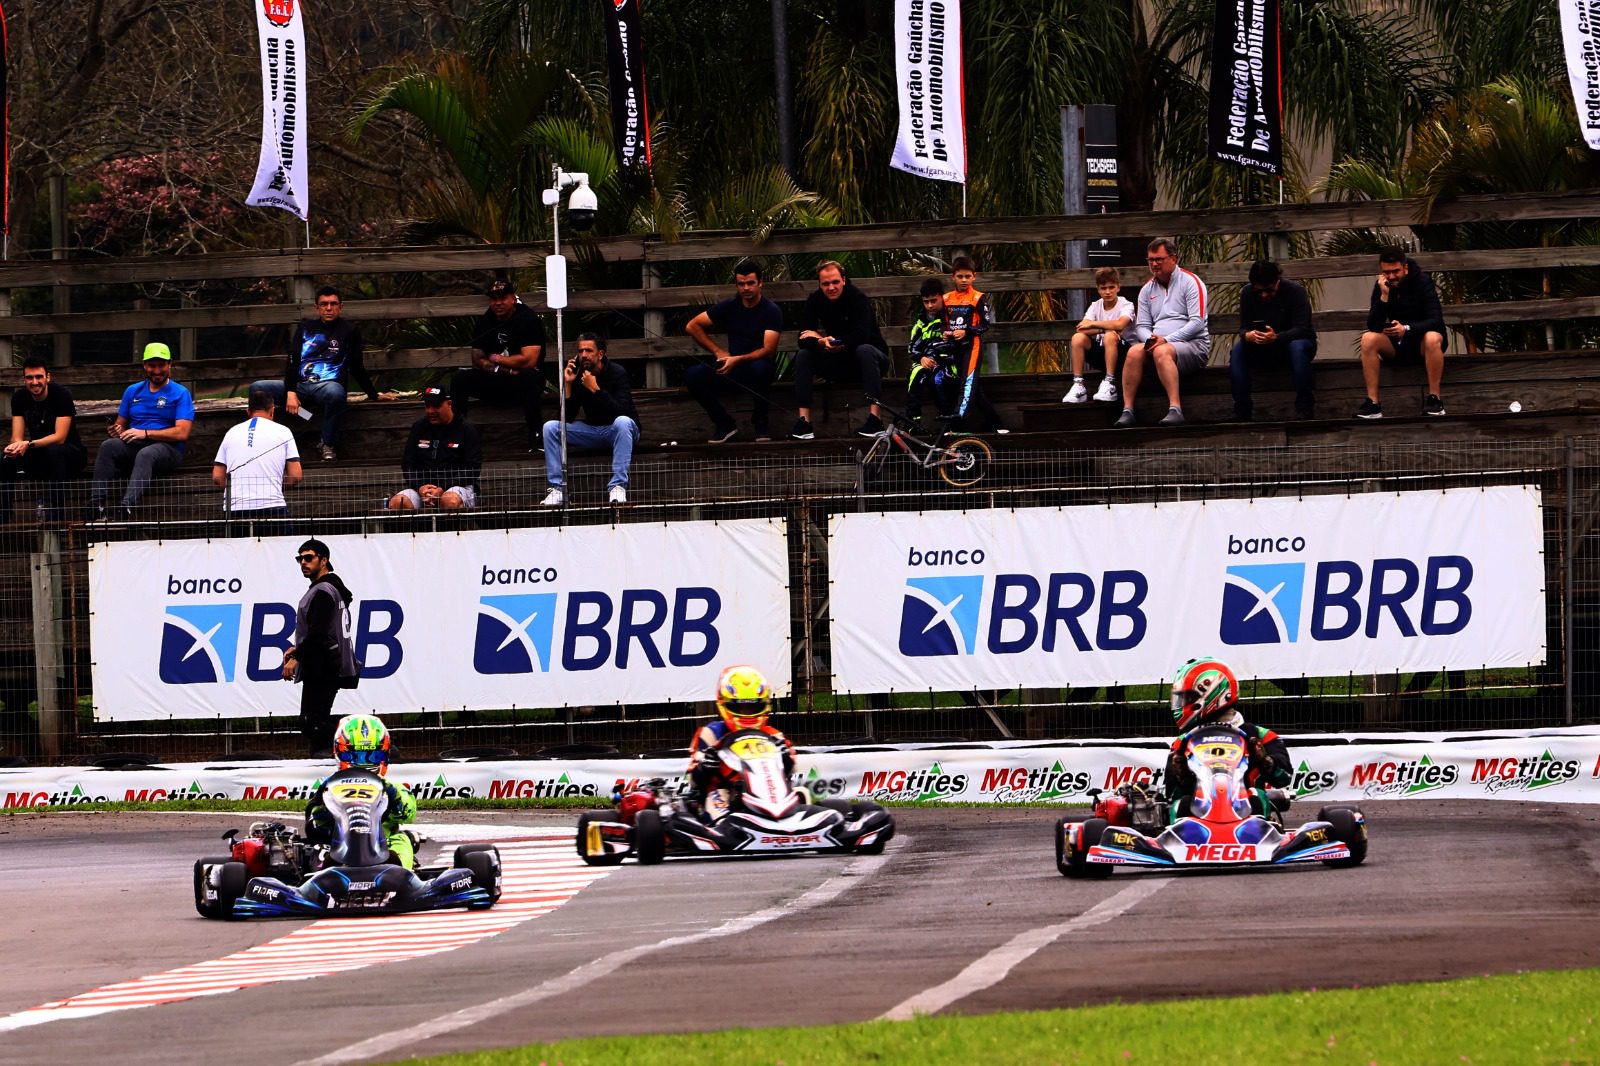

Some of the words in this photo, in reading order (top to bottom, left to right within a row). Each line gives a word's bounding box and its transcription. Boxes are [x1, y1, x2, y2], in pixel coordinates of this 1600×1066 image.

[908, 0, 924, 65] Gaúcha
[1232, 0, 1248, 55] Gaúch
[928, 1, 946, 133] Automobilismo
[1580, 40, 1600, 130] Federação
[280, 38, 297, 171] Automobilismo
[906, 69, 929, 159] Federação
[1226, 59, 1251, 148] Federação
[622, 86, 639, 167] ederação
[932, 138, 948, 162] De
[1251, 128, 1271, 153] De
[1216, 151, 1277, 173] www.fgars.org
[908, 546, 985, 566] banco
[1227, 534, 1306, 555] banco
[167, 575, 242, 595] banco
[481, 564, 558, 585] banco
[1310, 555, 1474, 642] BRB
[987, 569, 1149, 655] BRB
[246, 599, 404, 682] BB
[561, 586, 722, 672] BRB
[858, 767, 967, 794] MGtires
[980, 767, 1090, 793] MGtires
[1350, 761, 1456, 786] MGtires
[1471, 756, 1578, 782] MGtires
[340, 787, 374, 799] 25
[403, 781, 472, 799] tires
[488, 778, 597, 799] MGtires
[874, 786, 920, 801] Racing
[994, 785, 1042, 802] Racing
[1365, 779, 1411, 799] Racing
[1485, 774, 1533, 793] Racing
[1113, 832, 1138, 846] 18K
[1185, 844, 1257, 862] MEGA
[252, 885, 280, 901] FIORE
[450, 876, 472, 891] FIORE
